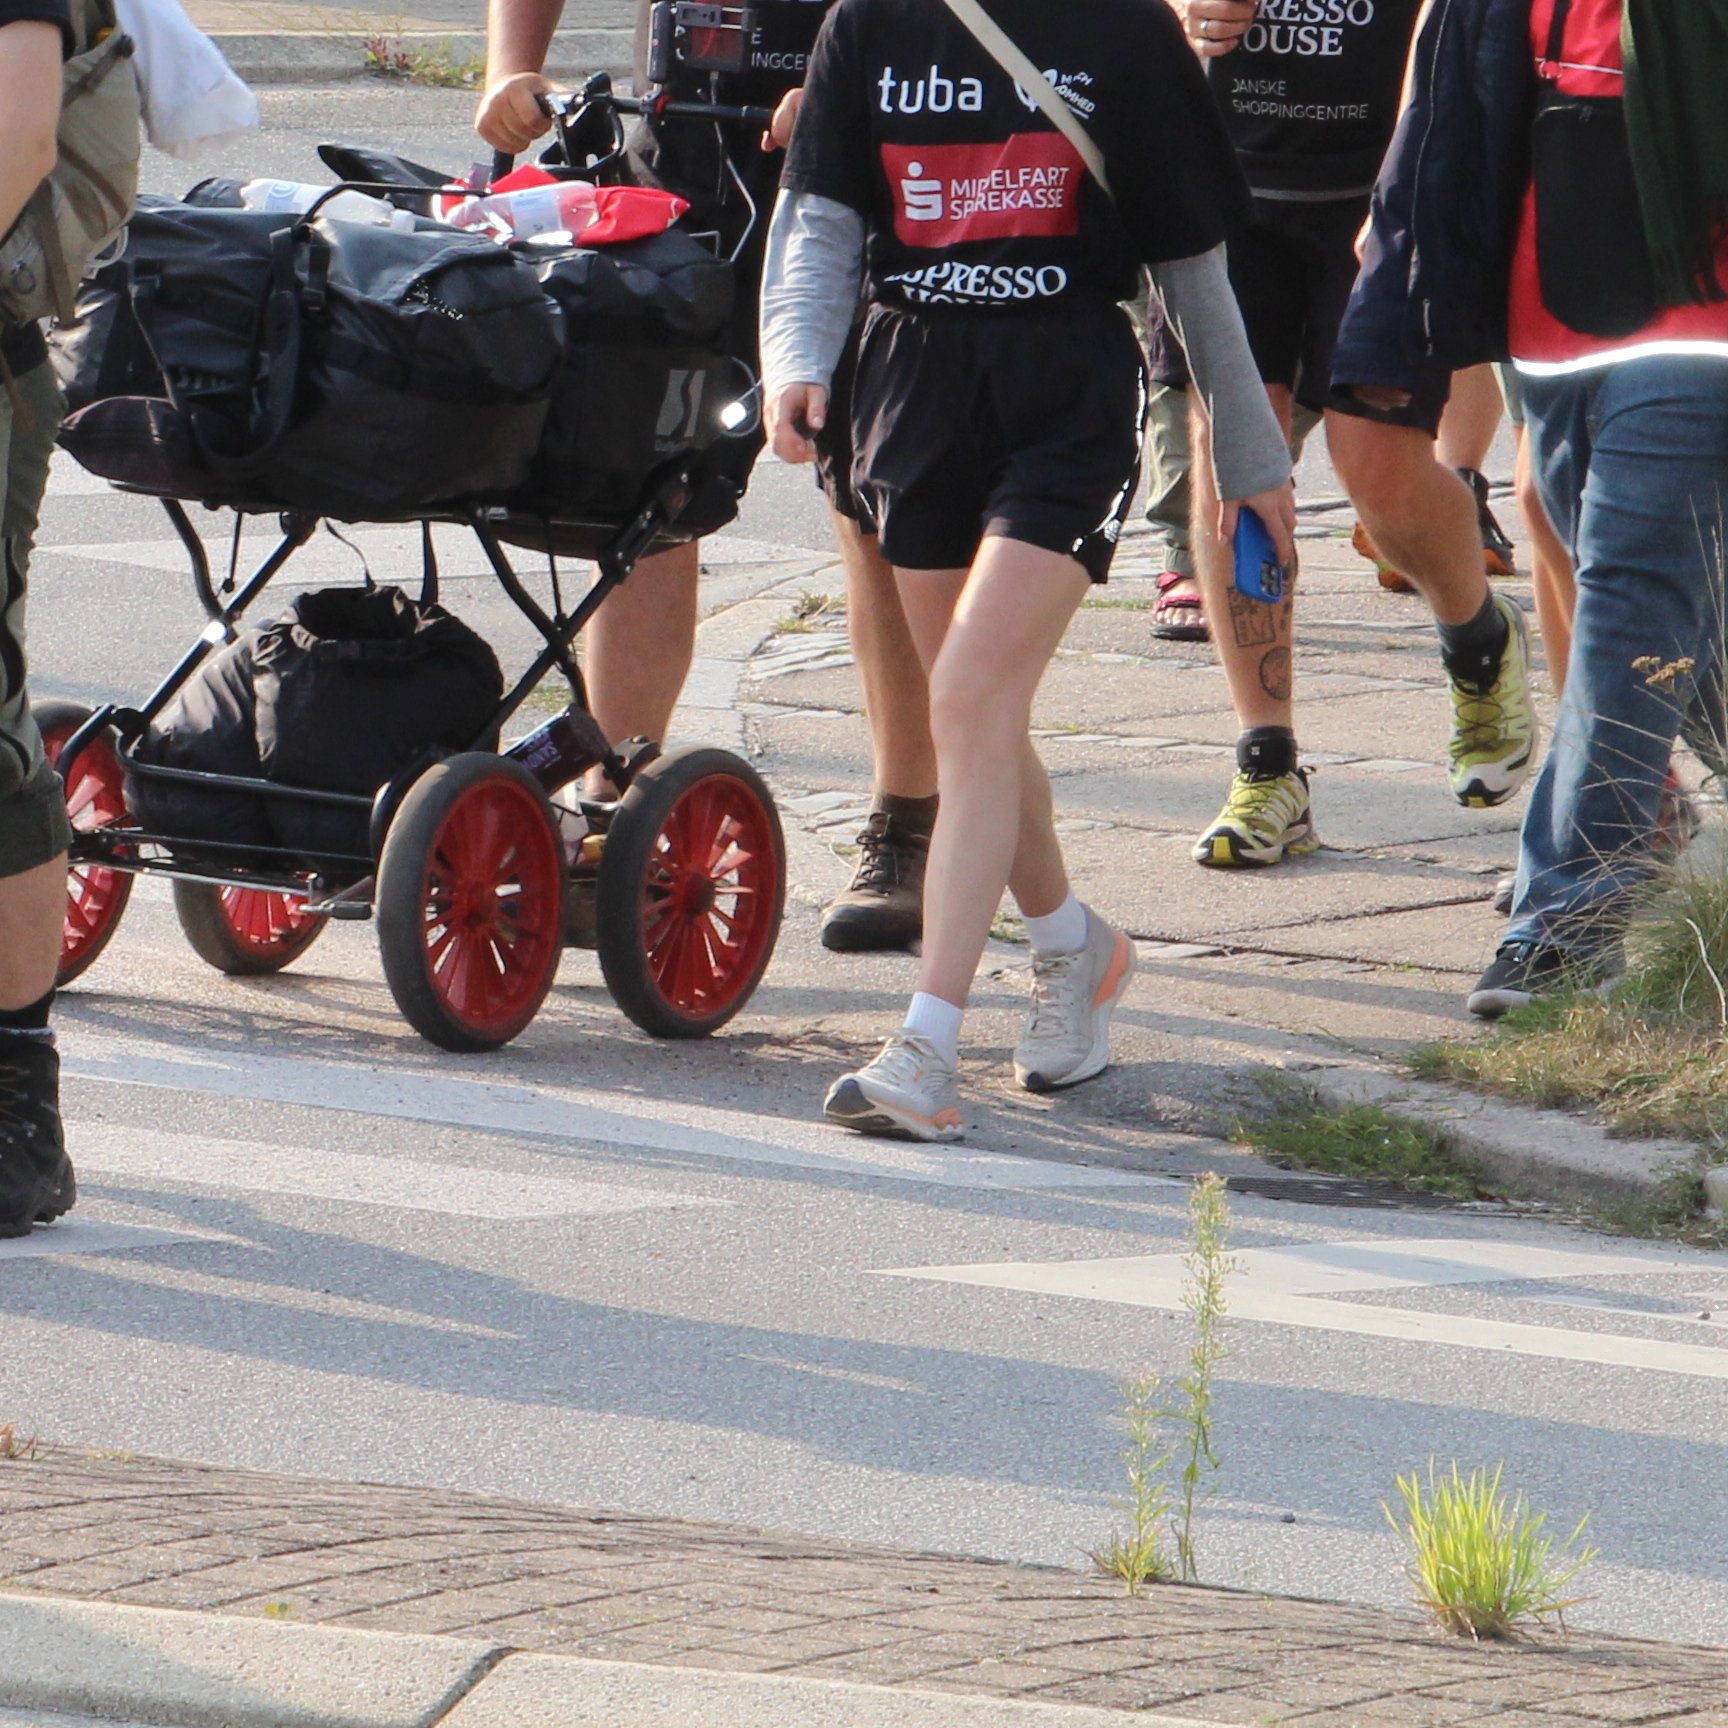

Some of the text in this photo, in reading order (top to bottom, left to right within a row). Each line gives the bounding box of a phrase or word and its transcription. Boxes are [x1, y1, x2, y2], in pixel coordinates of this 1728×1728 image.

[878, 64, 983, 113] tuba
[1232, 78, 1287, 97] DANSKE
[1232, 99, 1369, 121] SHOPPINGCENTRE
